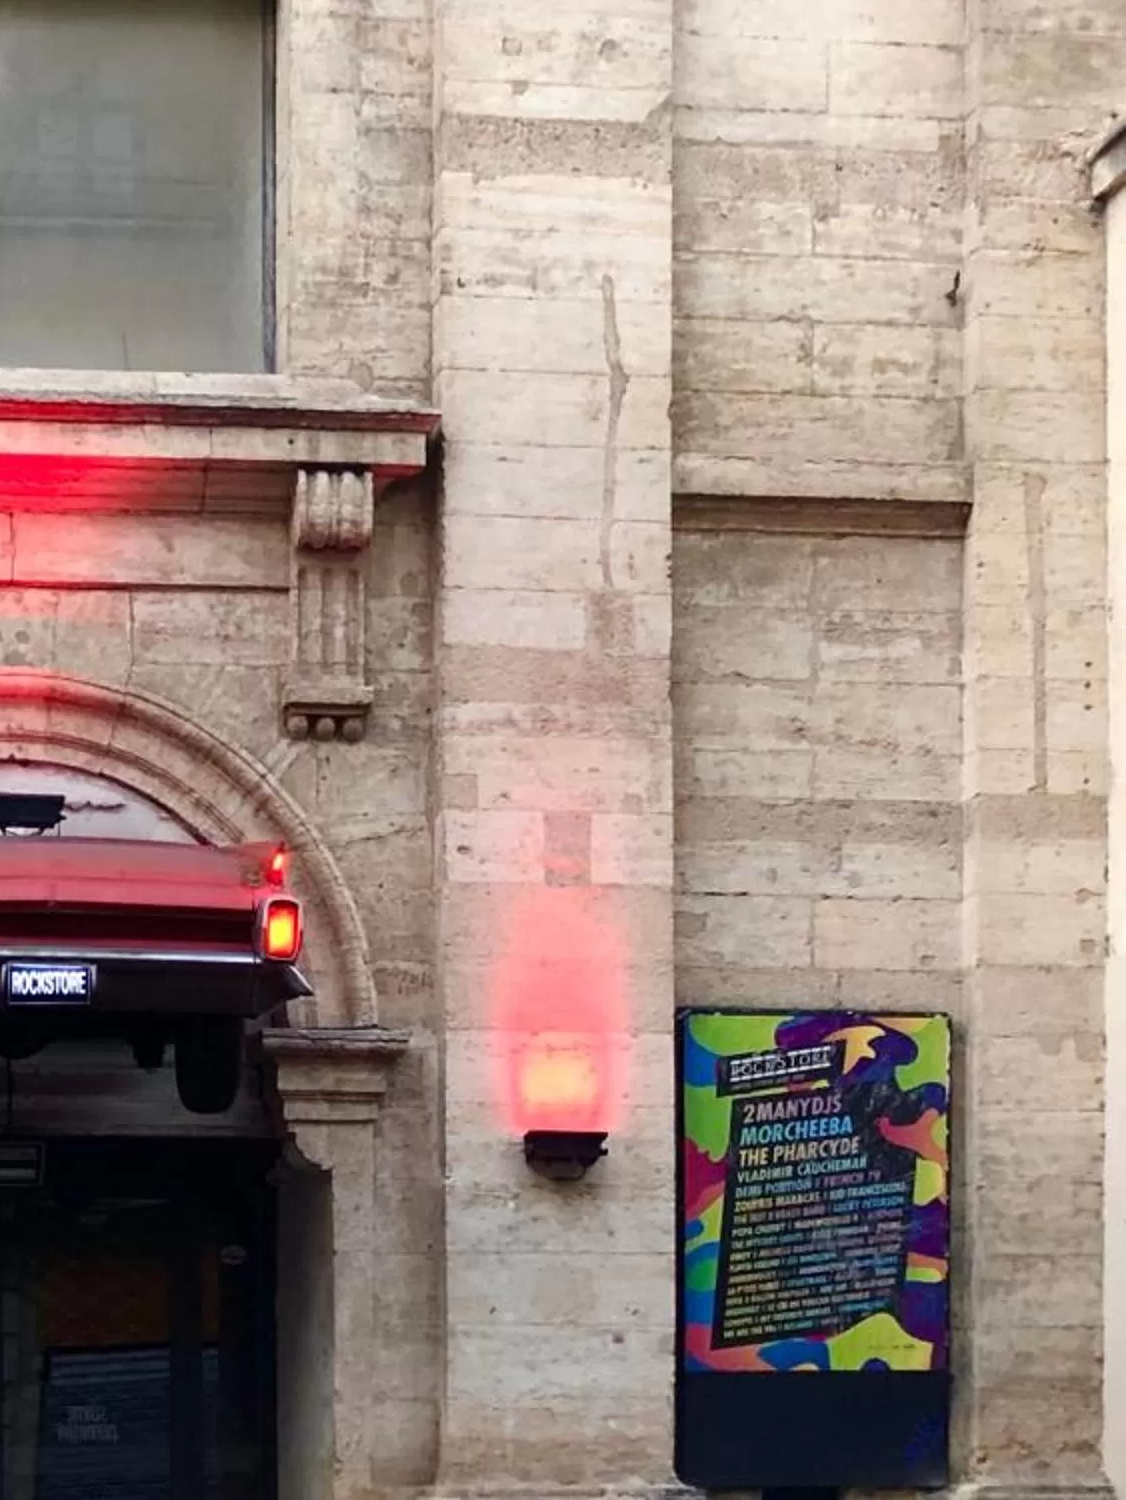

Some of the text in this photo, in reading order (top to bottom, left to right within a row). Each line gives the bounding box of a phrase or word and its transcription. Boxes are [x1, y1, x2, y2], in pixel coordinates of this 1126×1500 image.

[11, 970, 87, 995] ROCKSTORE
[743, 1095, 843, 1124] 2MANYDJS
[740, 1115, 853, 1146] MORCHEEBA
[739, 1136, 860, 1168] THE PHARCYDE
[737, 1165, 794, 1184] VLADIMIR
